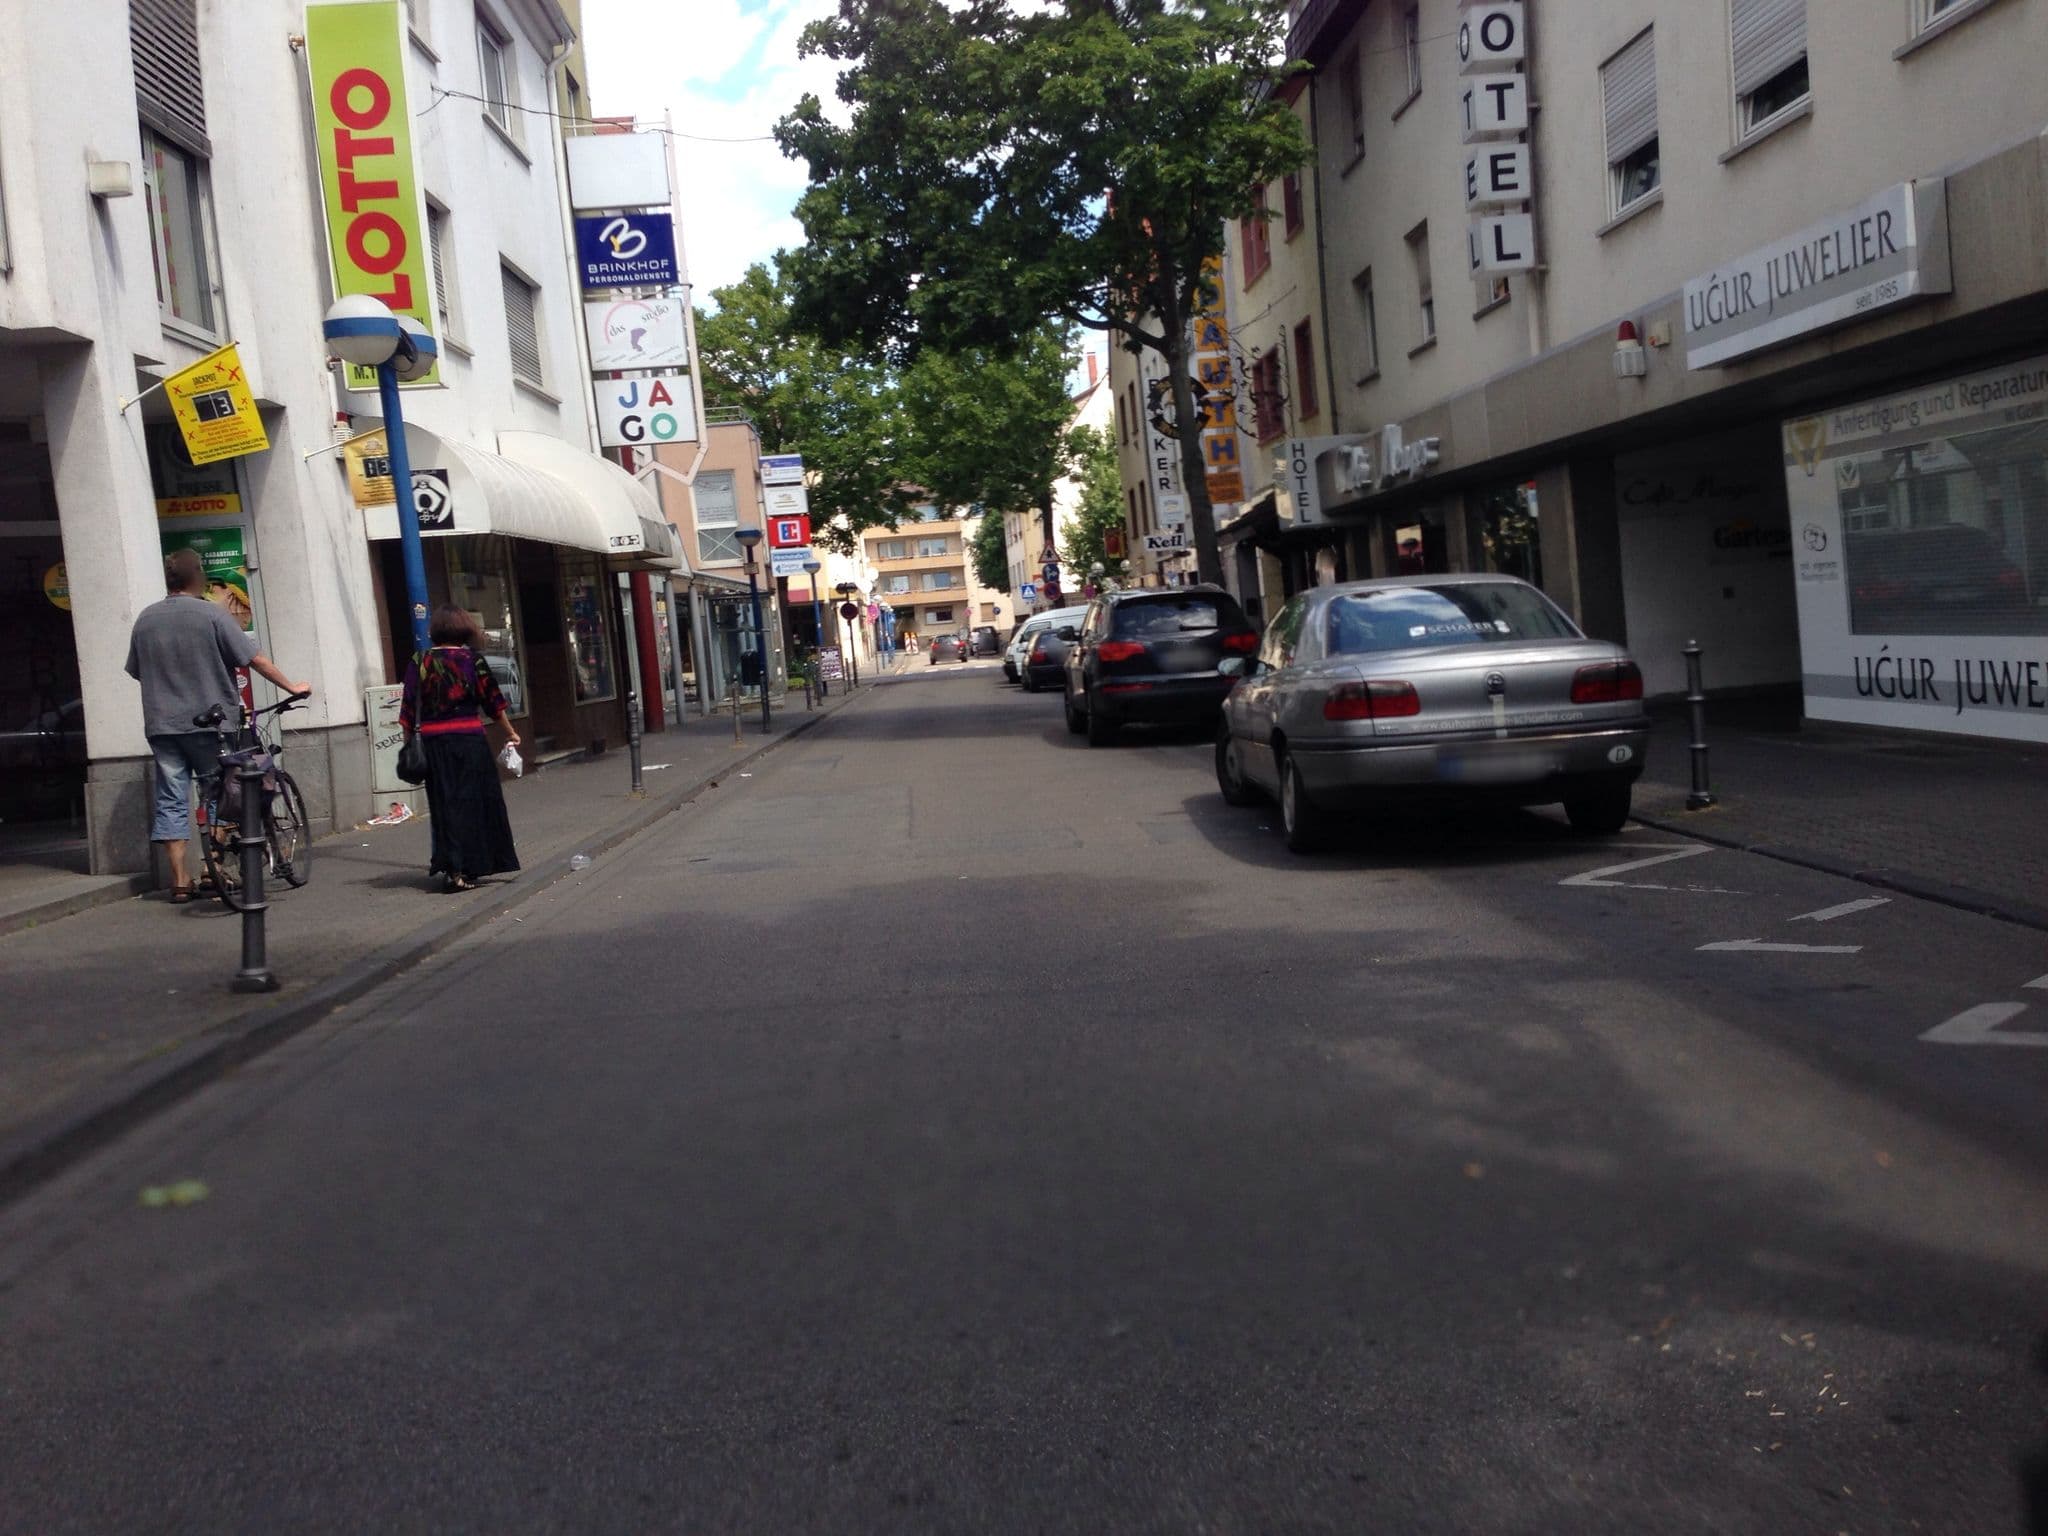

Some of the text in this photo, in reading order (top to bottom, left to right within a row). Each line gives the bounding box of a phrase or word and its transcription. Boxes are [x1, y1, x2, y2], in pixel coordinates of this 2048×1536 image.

[331, 68, 412, 310] LOTTO
[588, 258, 670, 274] BRINKHOF
[1766, 210, 1897, 316] JUWELIER
[589, 272, 671, 284] PERSONALDIENSTE
[641, 303, 669, 322] studio
[609, 324, 626, 337] das
[1924, 391, 1955, 416] und
[620, 412, 678, 442] GO
[1292, 442, 1312, 523] HOTEL
[185, 499, 226, 512] LOTTO
[1955, 659, 2048, 715] JUWE
